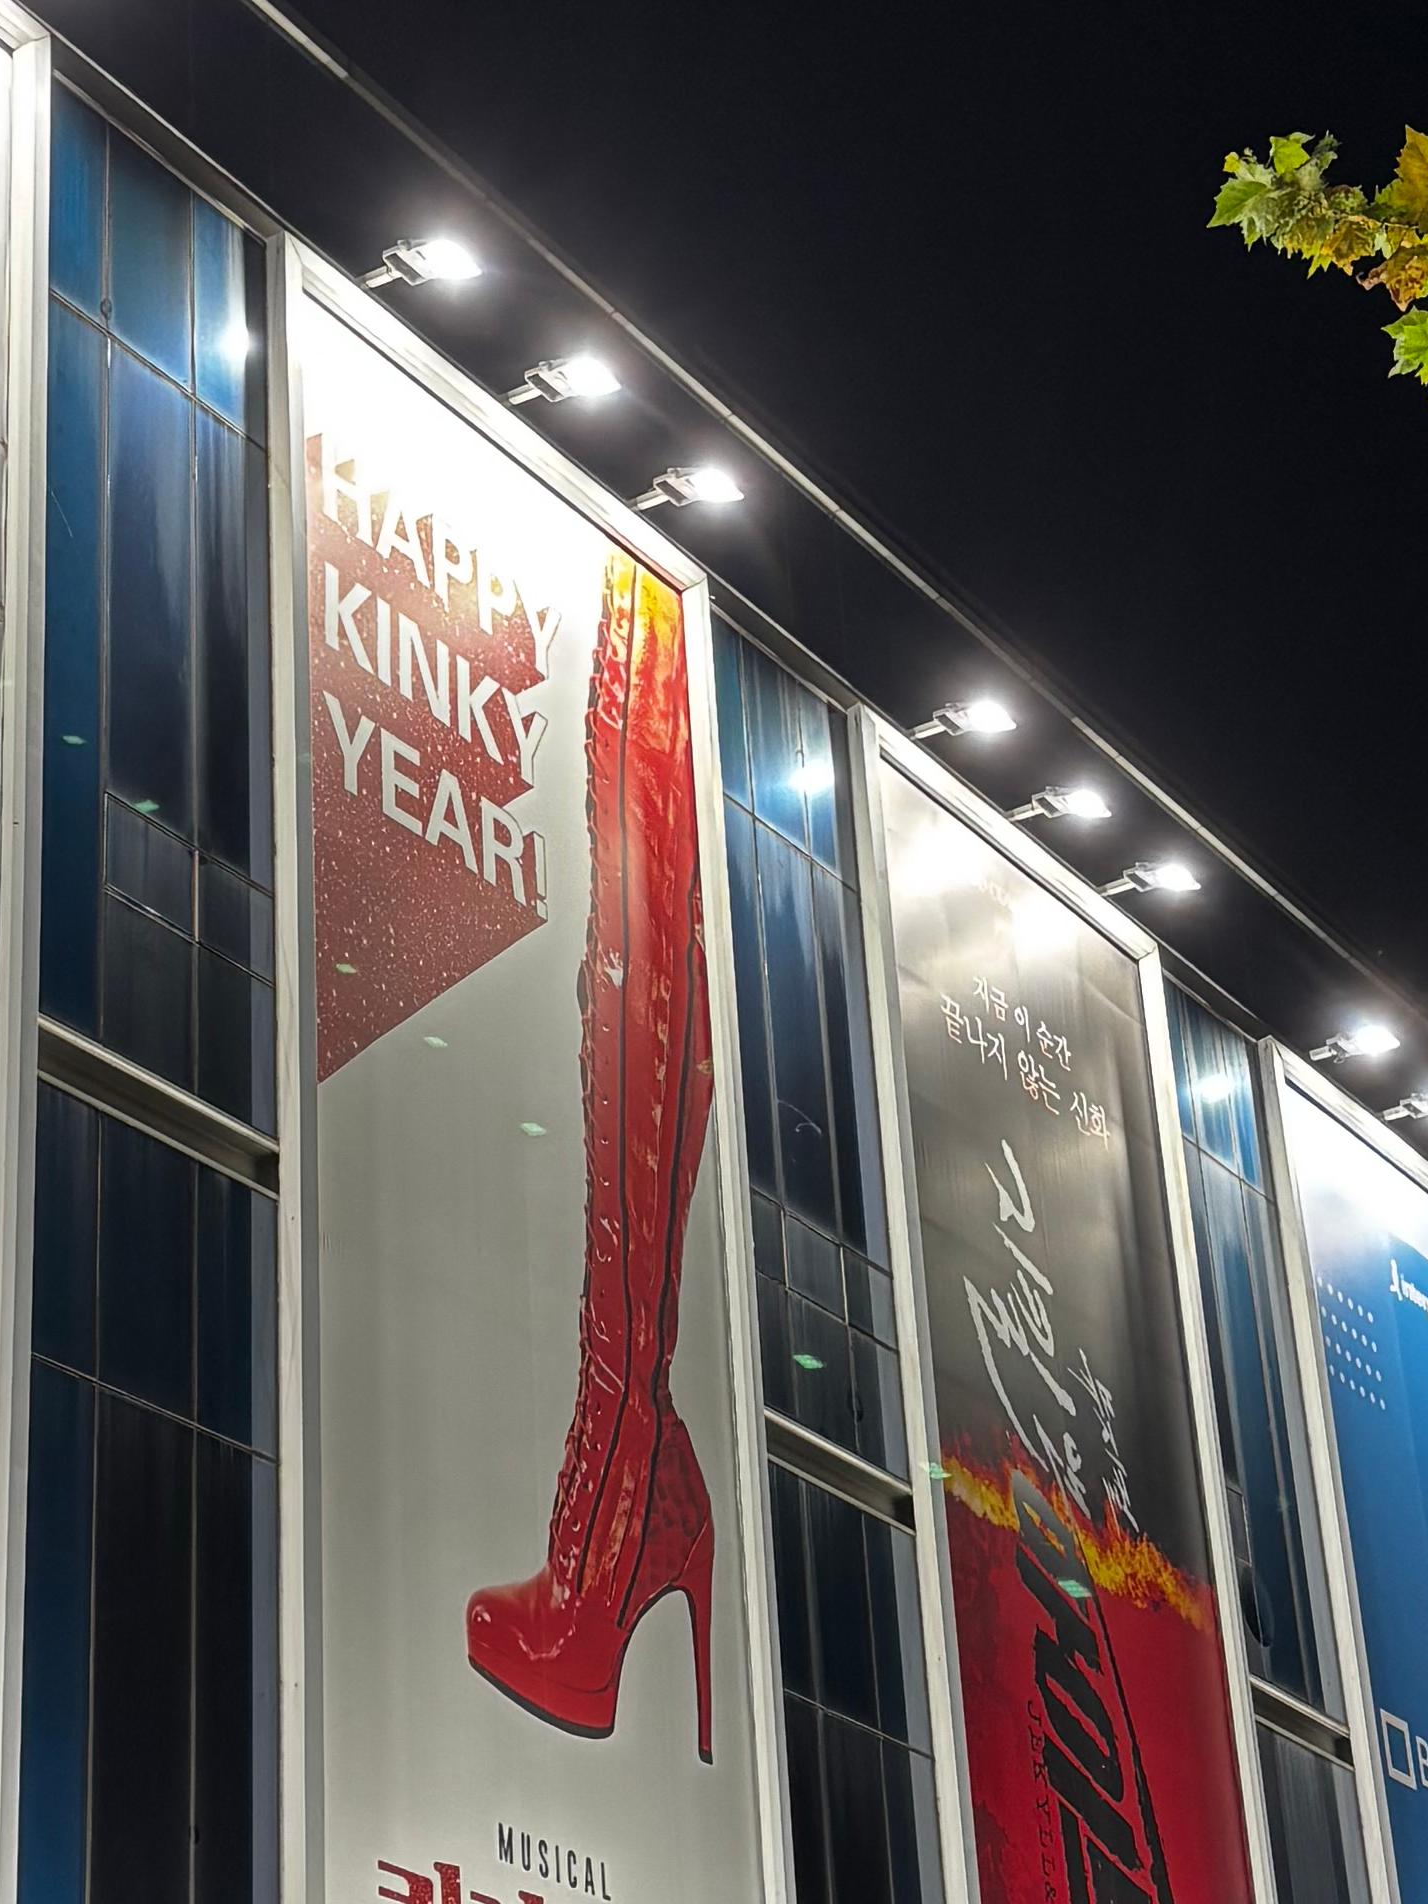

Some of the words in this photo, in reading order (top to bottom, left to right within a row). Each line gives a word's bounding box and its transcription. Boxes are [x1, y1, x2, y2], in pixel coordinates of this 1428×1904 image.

[324, 562, 549, 786] KINKY
[324, 690, 549, 922] YEAR!
[940, 993, 1008, 1080] 끝나지
[1017, 1050, 1060, 1115] 않는
[1070, 1091, 1111, 1151] 신화
[972, 976, 1009, 1022] 지금
[1014, 1005, 1031, 1043] 이
[1036, 1021, 1071, 1072] 순간
[497, 1822, 612, 1902] MUSICAL
